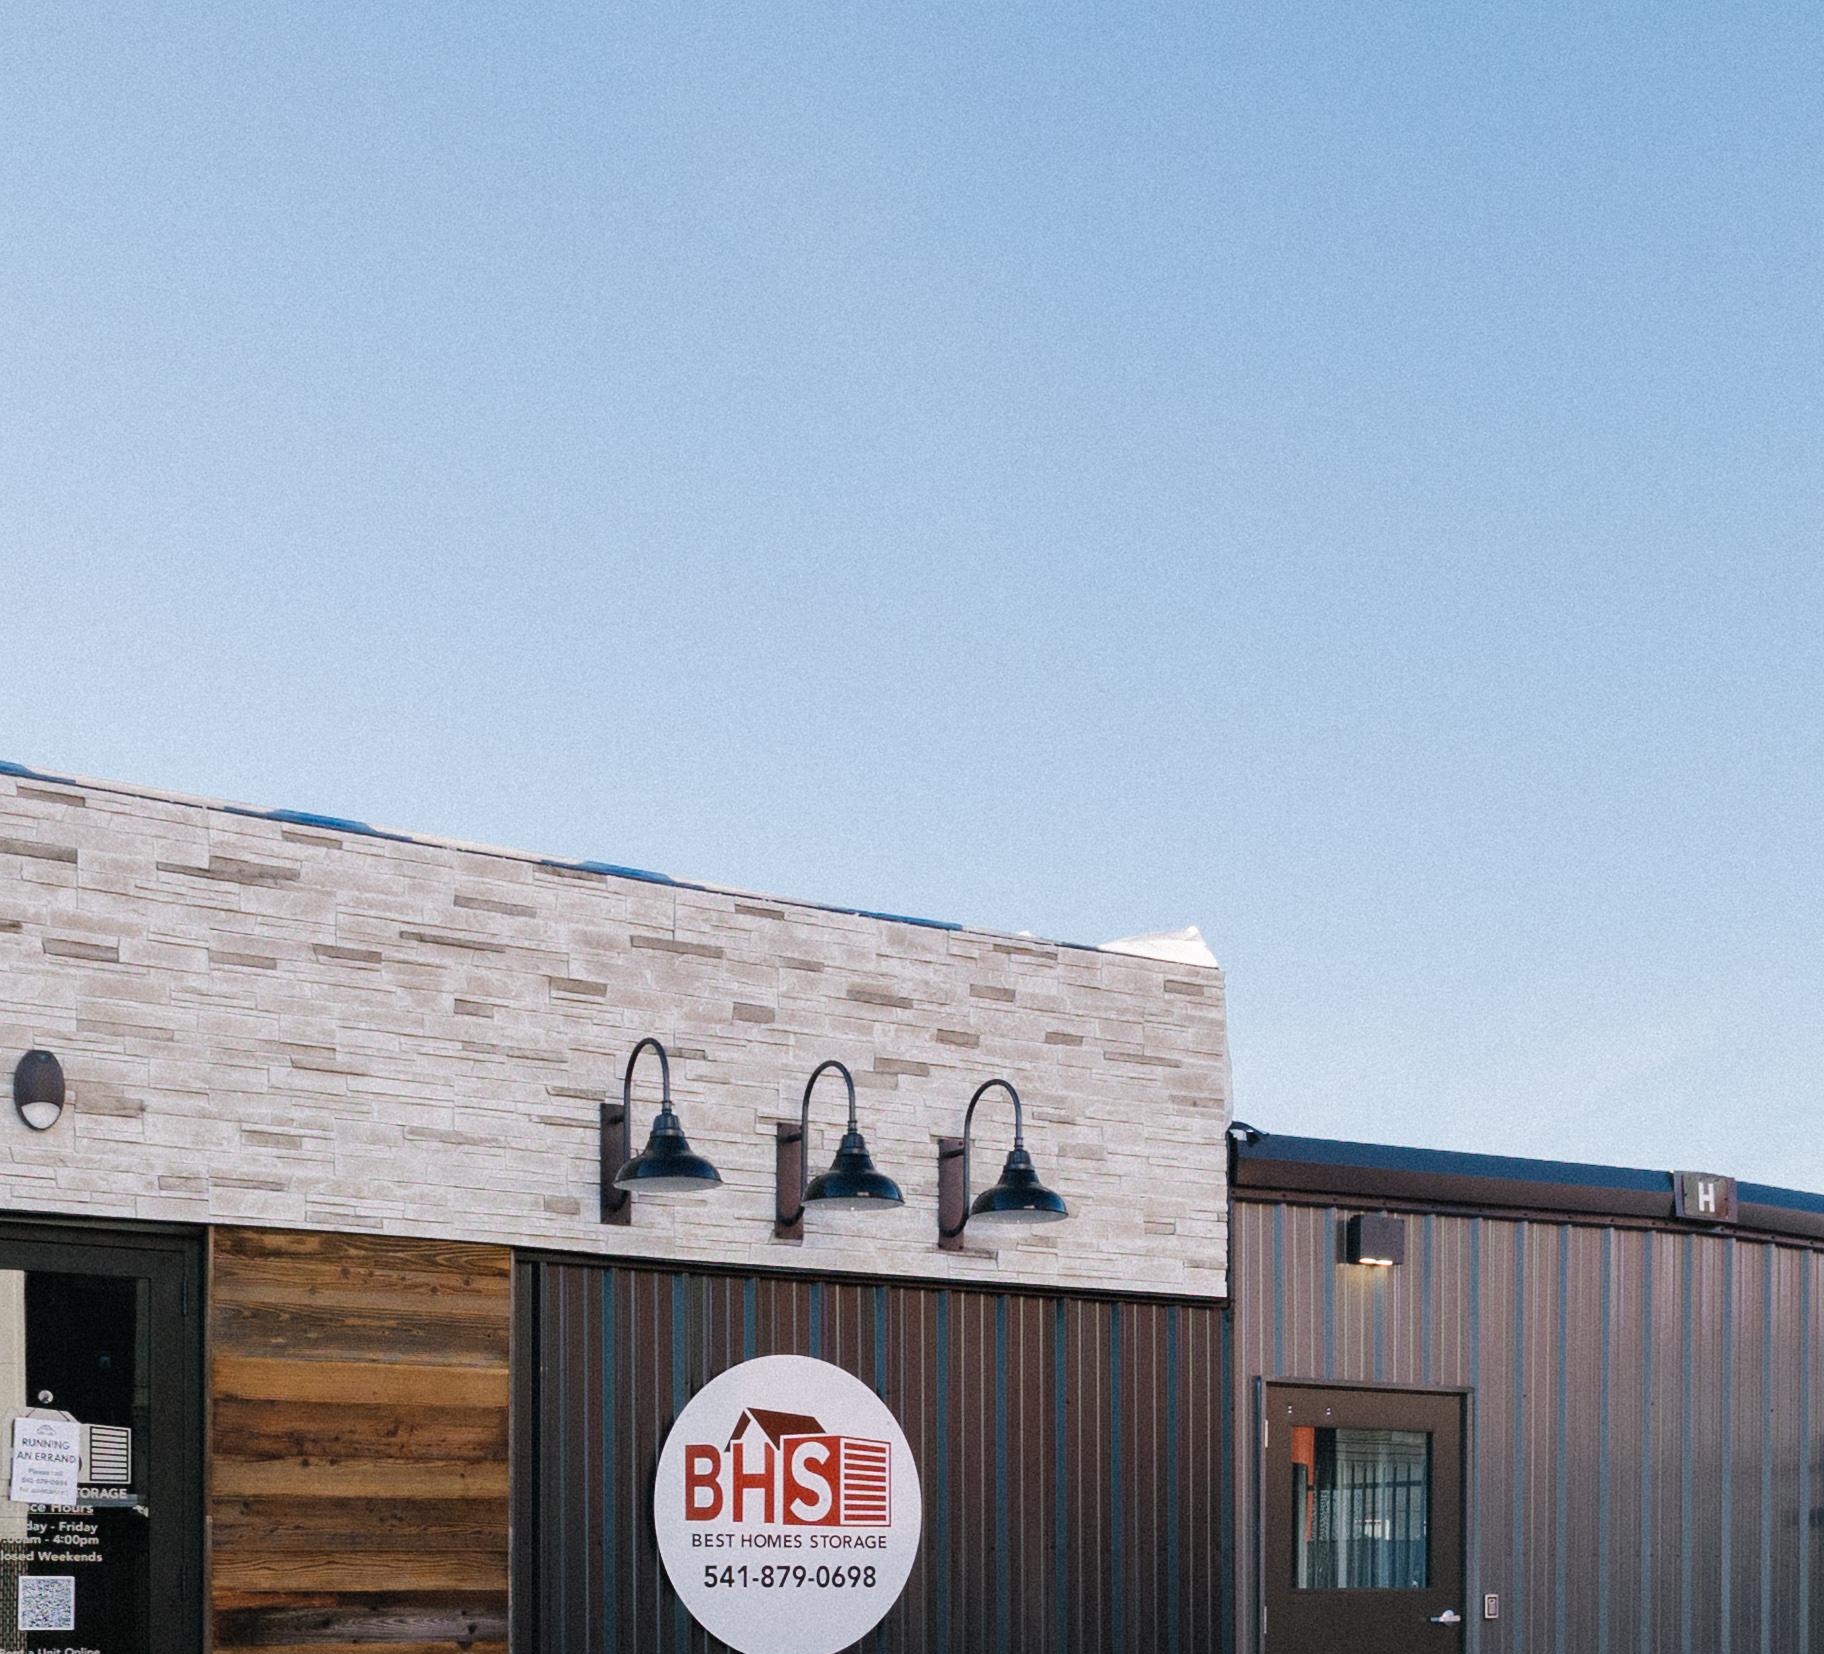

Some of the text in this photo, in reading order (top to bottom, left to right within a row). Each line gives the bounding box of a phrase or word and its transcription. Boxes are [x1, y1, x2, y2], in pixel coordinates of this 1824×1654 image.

[1698, 1182, 1715, 1213] H
[22, 1438, 70, 1450] RUNNING
[16, 1451, 76, 1463] AN ERRAND
[684, 1438, 838, 1525] BHS
[76, 1486, 128, 1500] TORAGE
[51, 1503, 94, 1514] Hours
[59, 1521, 98, 1535] Friday
[53, 1534, 100, 1547] 4:00pm
[691, 1533, 888, 1550] BEST HOMES STORAGE
[38, 1551, 103, 1562] Weekends
[704, 1565, 877, 1588] 541-879-0698
